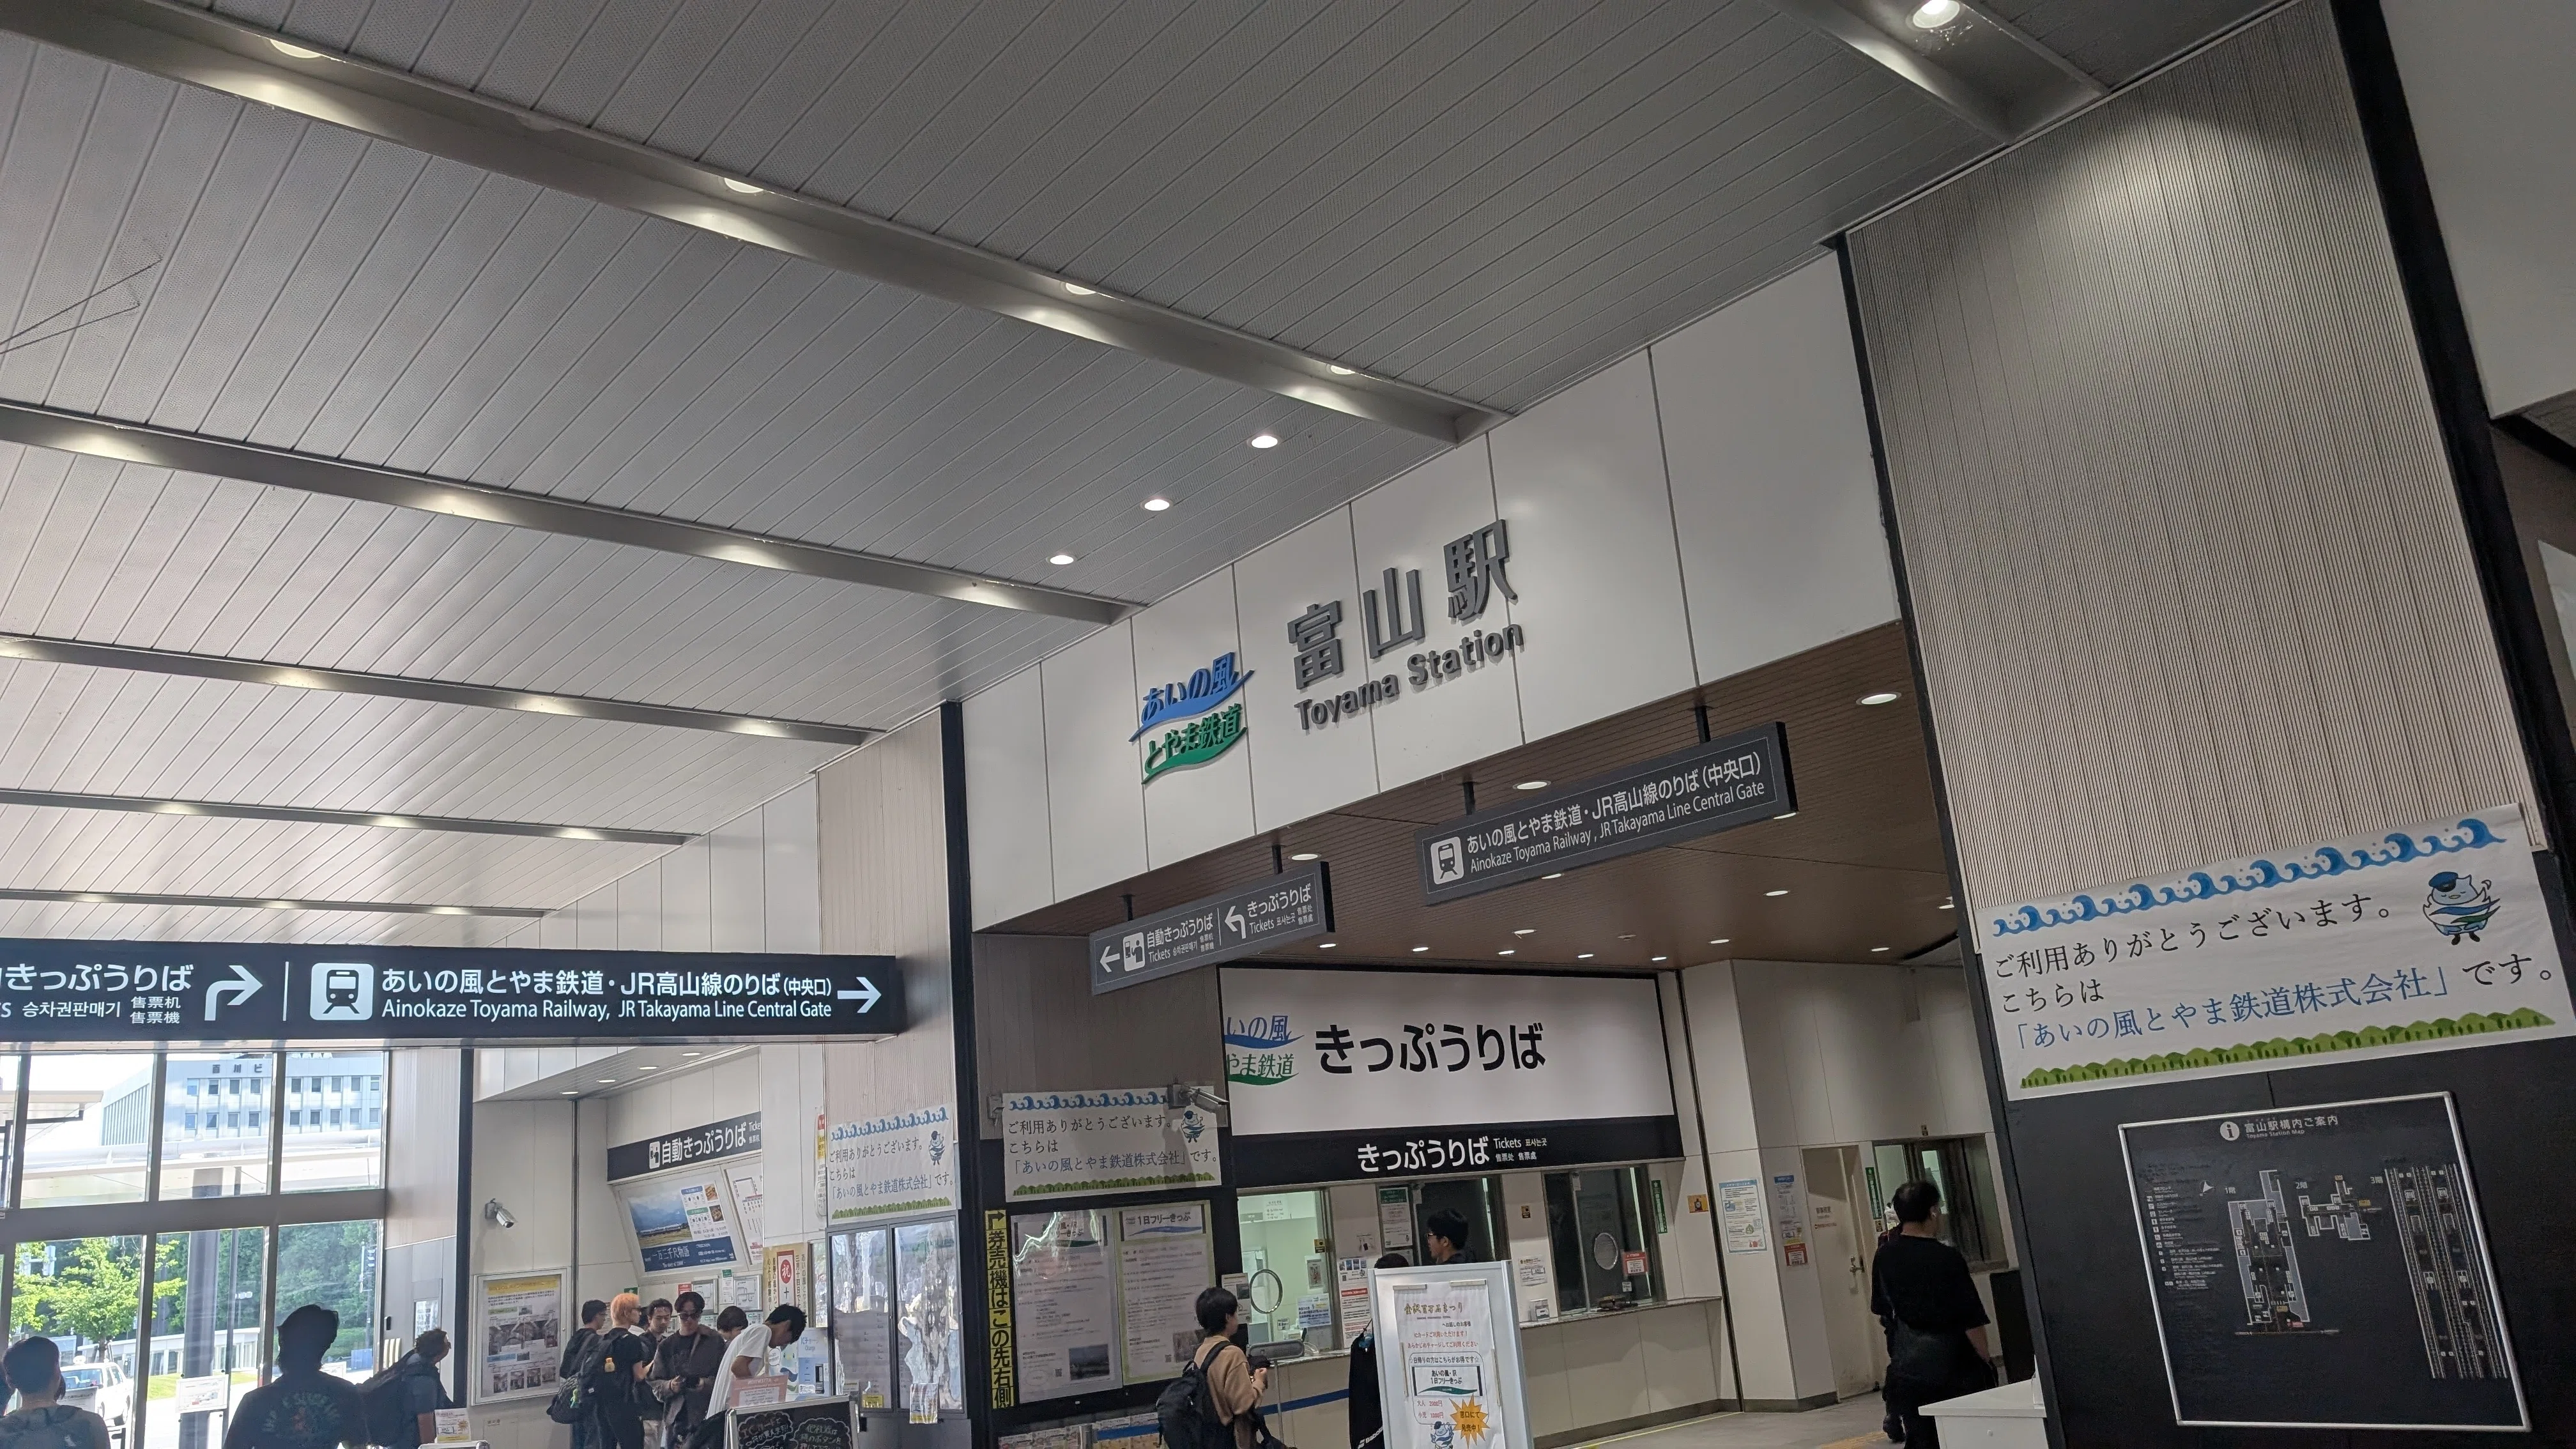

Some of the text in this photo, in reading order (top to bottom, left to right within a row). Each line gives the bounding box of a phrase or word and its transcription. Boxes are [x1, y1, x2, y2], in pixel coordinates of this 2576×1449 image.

[1287, 519, 1517, 691] 富山駅
[1141, 652, 1239, 724] あいの風
[1294, 624, 1524, 730] Toyama Station
[1144, 703, 1243, 776] とやま鉄道
[1470, 850, 1512, 873] Ainokaze
[1513, 841, 1551, 864] Toyama
[1600, 822, 1612, 839] JR
[1611, 809, 1665, 836] Takayama
[1667, 801, 1691, 820] Line
[1693, 791, 1735, 815] Central
[1736, 781, 1765, 801] Gate
[1247, 883, 1312, 918] きっぷうりば
[1147, 913, 1214, 949] 自動きっぷうりば
[1249, 918, 1275, 935] Tickets
[1995, 893, 2389, 979] ご利用ありがとうございます。
[1148, 948, 1170, 963] Tickets
[0, 963, 194, 992] きっぷうりば
[22, 1000, 121, 1018] 승차권판매기
[130, 996, 181, 1009] 售票机
[382, 999, 832, 1022] Ainokaze Toyama Railway, JR Takayama Line Central Gate
[2004, 979, 2104, 1013] こちらは
[130, 1011, 181, 1024] 售票機
[1315, 1022, 1546, 1075] きっぷうりば
[1008, 1114, 1172, 1135] ご利用ありがとうございます。
[662, 1122, 747, 1165] 自動きっぷうりば
[829, 1137, 923, 1163] ご利用ありがとうございます。
[1009, 1140, 1059, 1154] こちらは
[1357, 1135, 1489, 1173] きっぷうりば
[1493, 1137, 1522, 1149] Tickets
[829, 1167, 855, 1181] こちらは
[781, 1264, 792, 1279] 祝
[988, 1230, 1011, 1408] 券売機はこの先右側
